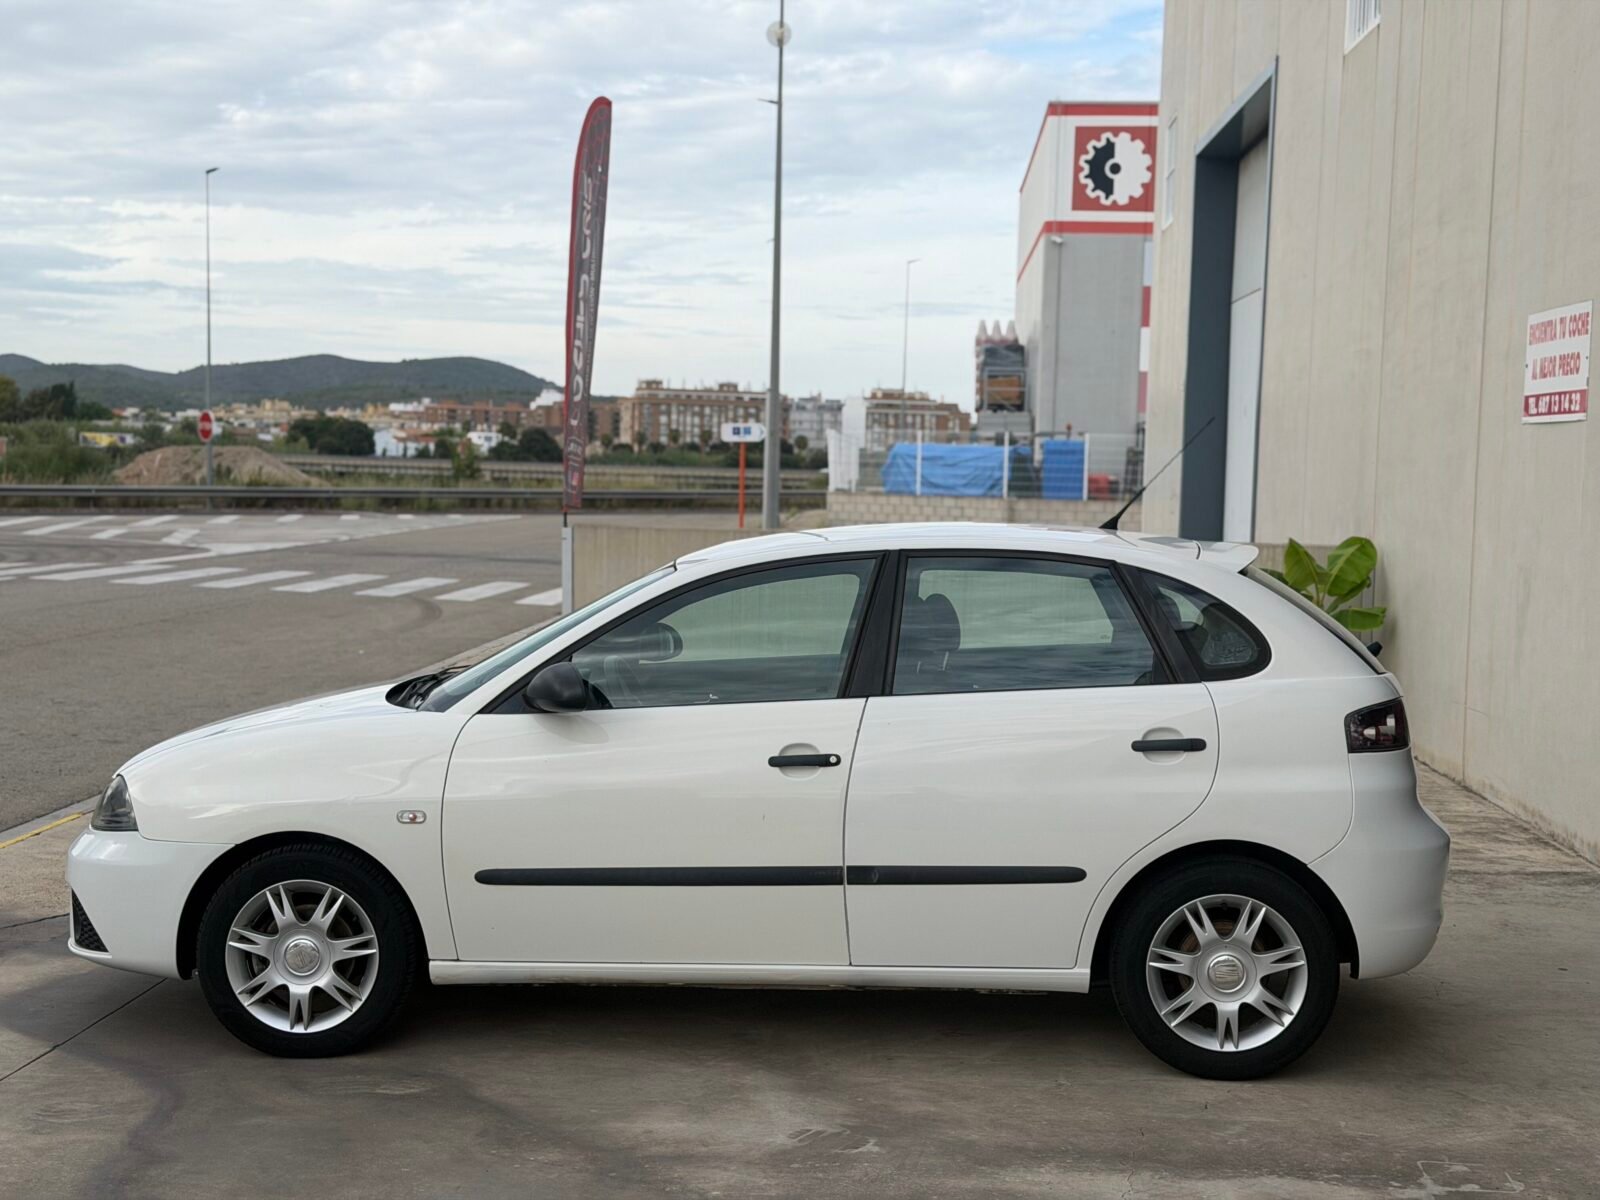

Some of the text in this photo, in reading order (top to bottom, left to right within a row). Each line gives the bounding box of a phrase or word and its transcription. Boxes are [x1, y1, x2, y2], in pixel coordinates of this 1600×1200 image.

[1559, 316, 1567, 340] TU
[1569, 312, 1590, 338] COCHE
[1540, 355, 1557, 380] MEJOR
[1559, 352, 1580, 376] PRECIO
